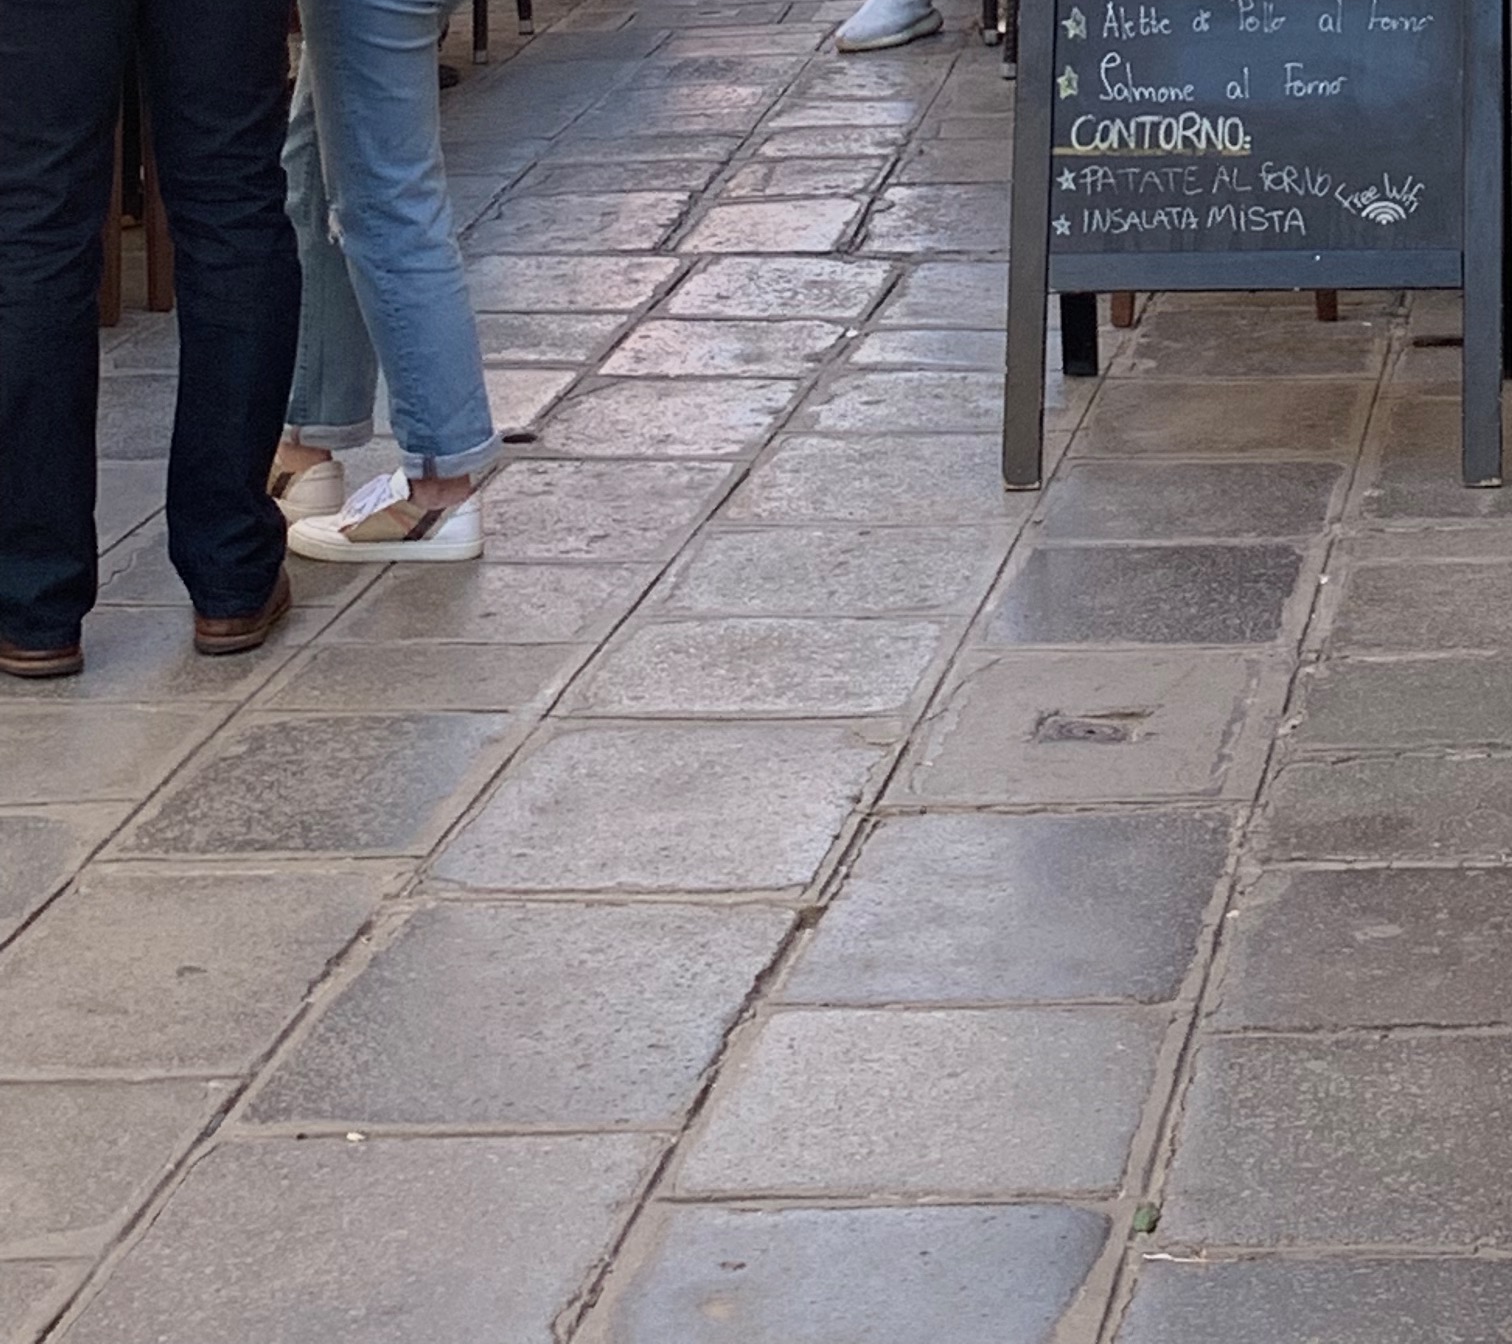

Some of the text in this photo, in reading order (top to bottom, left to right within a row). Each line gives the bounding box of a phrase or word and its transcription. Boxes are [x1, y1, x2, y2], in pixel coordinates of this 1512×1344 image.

[1099, 52, 1347, 102] Salmone al Forno
[1079, 165, 1202, 195] PATATE
[1212, 165, 1251, 193] AL
[1083, 208, 1199, 233] INSALATA
